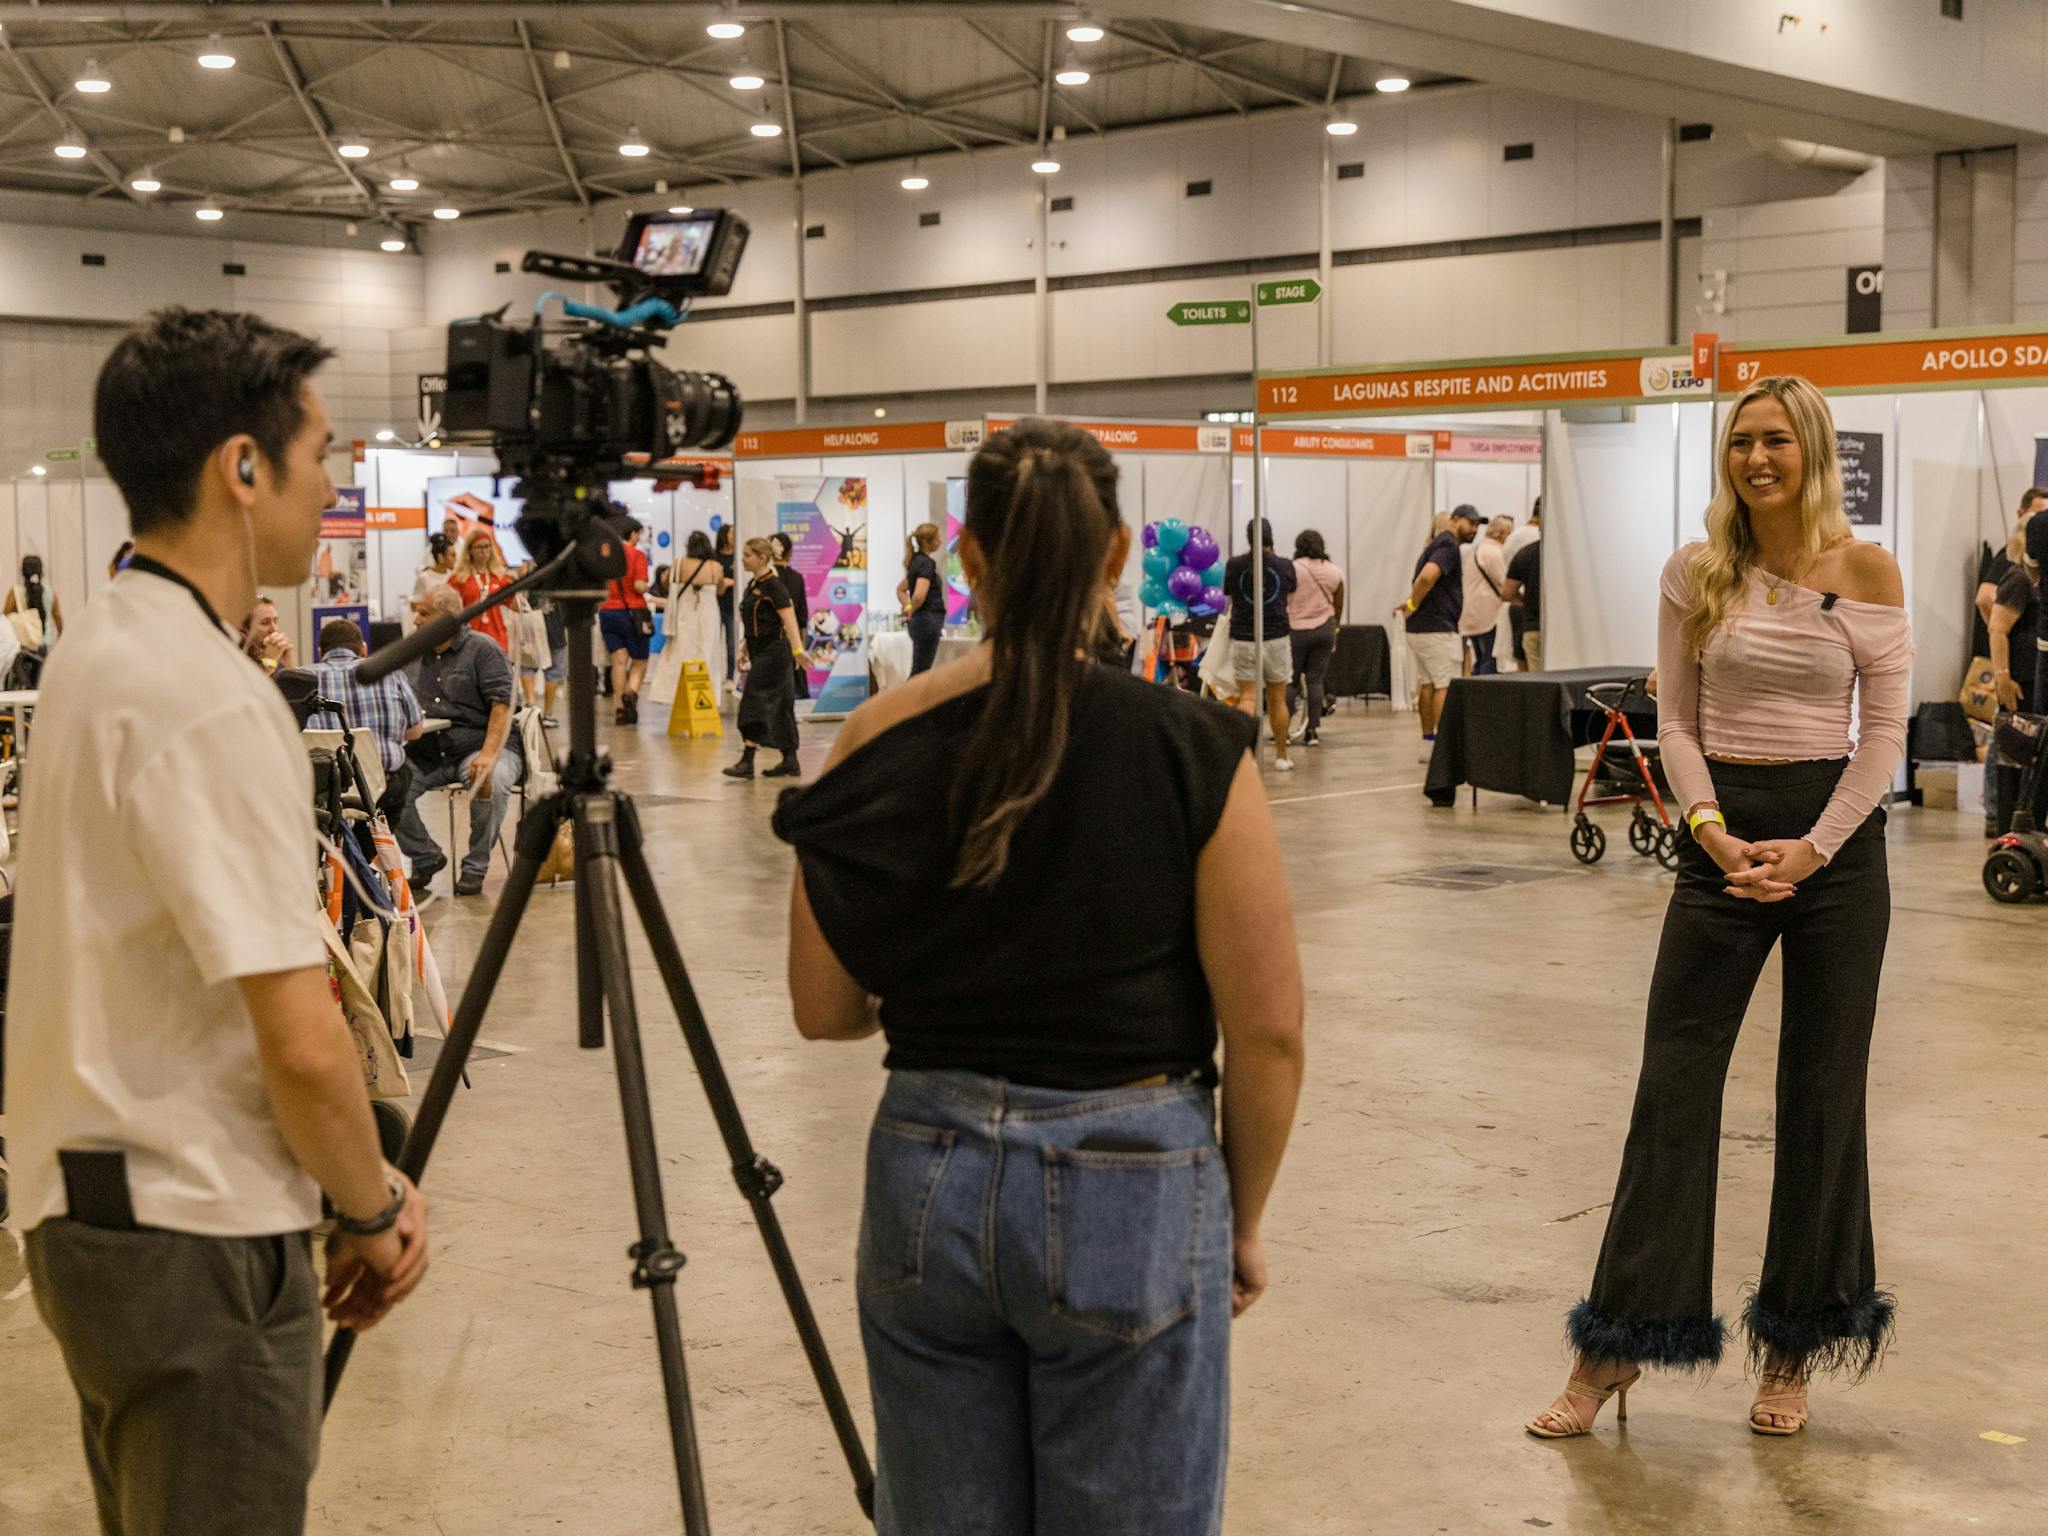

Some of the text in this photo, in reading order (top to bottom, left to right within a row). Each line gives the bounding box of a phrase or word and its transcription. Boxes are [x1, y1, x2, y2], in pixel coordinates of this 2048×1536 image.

[1275, 285, 1306, 299] STAGE
[1182, 307, 1227, 320] TOILETS
[1921, 346, 2008, 371] APOLLO
[1737, 361, 1760, 381] 87
[1271, 369, 1608, 404] 112 LAGUNAS RESPITE AND ACTIVITIES
[1672, 378, 1704, 389] EXPO
[742, 432, 879, 450] 113 HELPALONG
[1089, 429, 1138, 444] LPALONG
